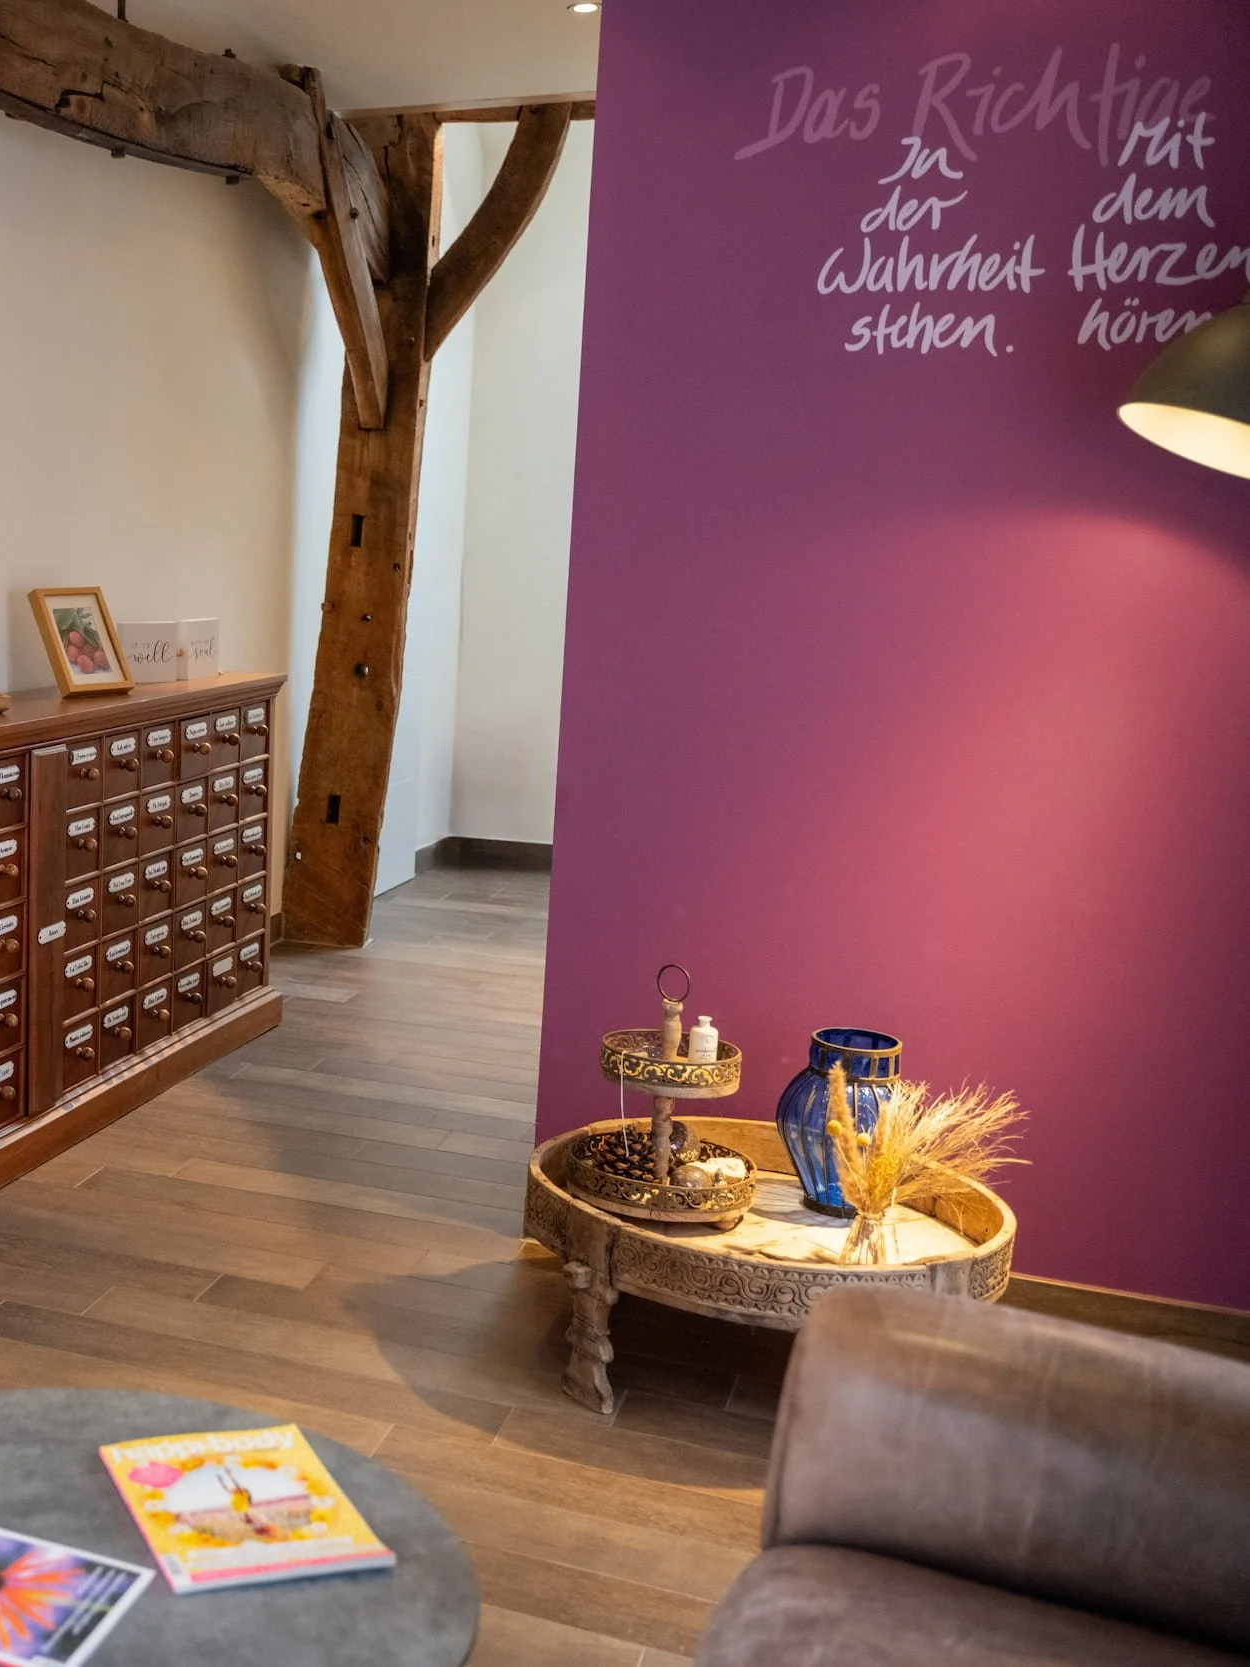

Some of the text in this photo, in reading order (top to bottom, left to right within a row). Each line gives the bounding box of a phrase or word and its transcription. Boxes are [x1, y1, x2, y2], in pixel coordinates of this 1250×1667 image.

[734, 66, 880, 160] Das
[1118, 111, 1216, 170] Mit
[878, 136, 963, 185] In
[860, 185, 968, 233] der
[1092, 173, 1216, 229] dem
[817, 234, 1045, 294] Wahrheit
[1067, 224, 1250, 292] Herzen
[845, 301, 1014, 358] stehen.
[127, 640, 175, 664] well
